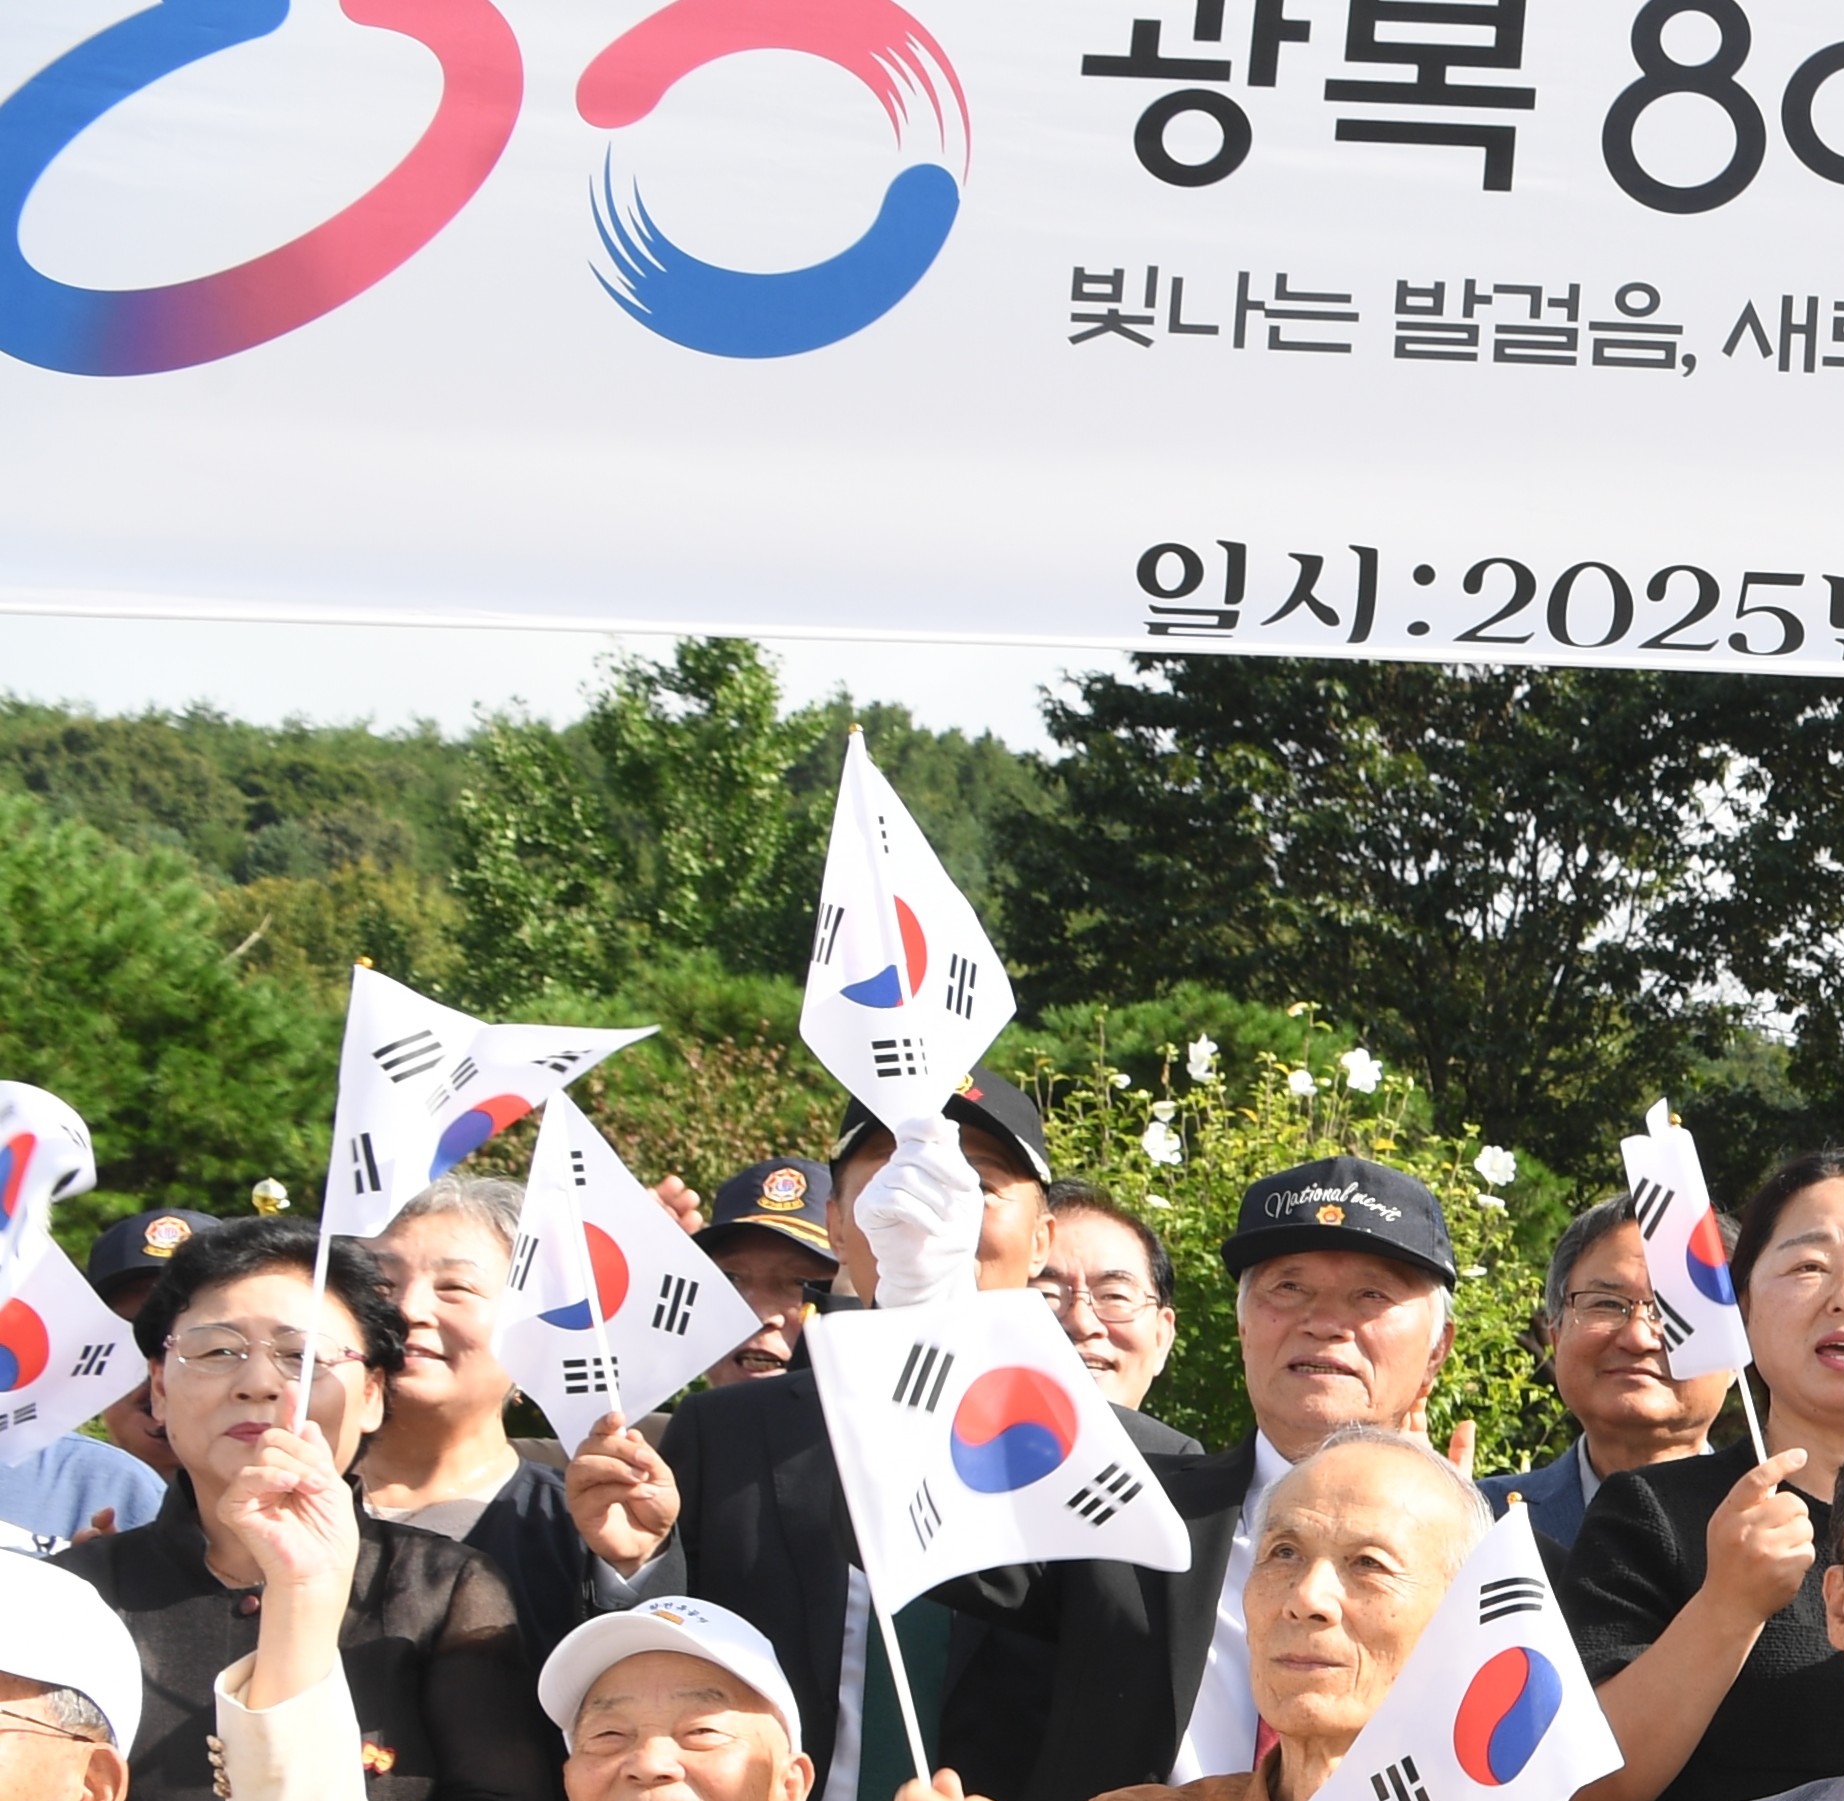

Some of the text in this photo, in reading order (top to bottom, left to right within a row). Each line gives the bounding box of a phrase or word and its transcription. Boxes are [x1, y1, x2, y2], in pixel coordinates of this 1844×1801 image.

[1082, 0, 1535, 191] 광복
[1068, 265, 1359, 353] 빛나는
[1394, 278, 1696, 377] 발걸음,
[1264, 1181, 1402, 1222] National merit
